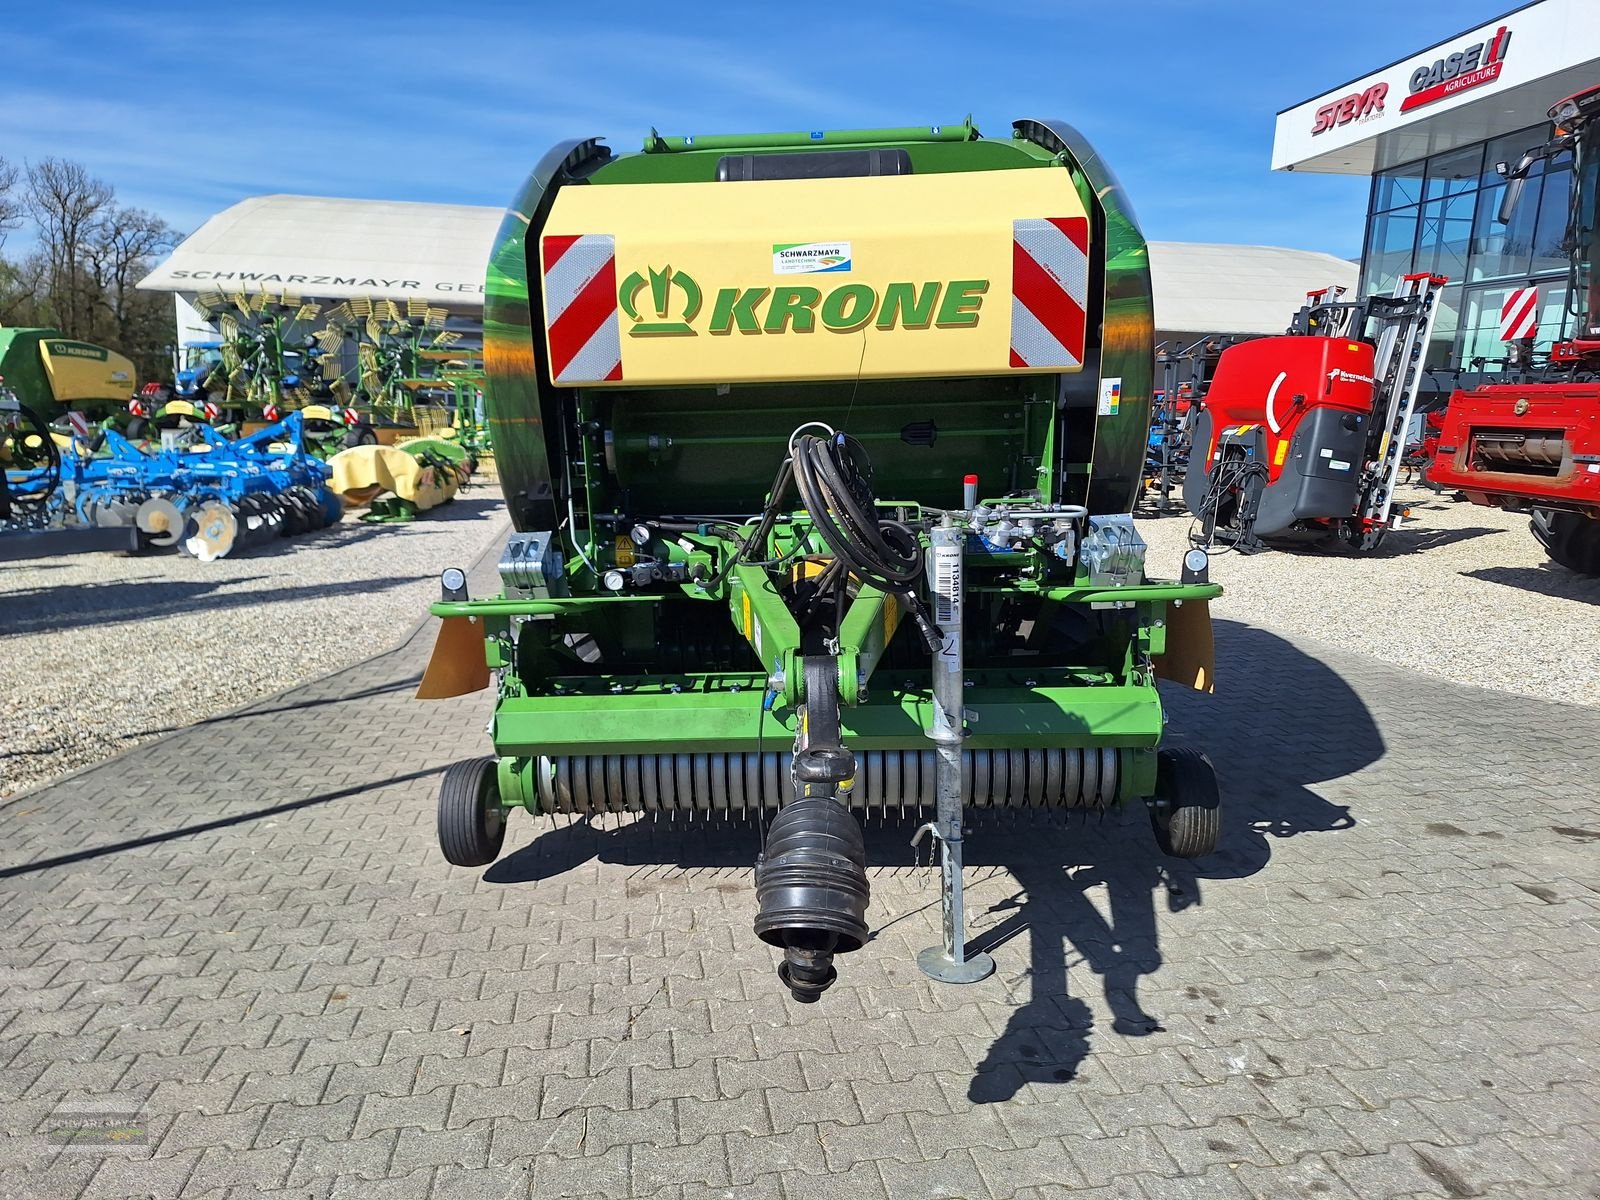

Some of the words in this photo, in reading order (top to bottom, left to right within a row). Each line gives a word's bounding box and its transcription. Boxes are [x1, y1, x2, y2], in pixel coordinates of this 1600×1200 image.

[1409, 43, 1484, 93] CASE
[1444, 66, 1496, 93] AGRICULTURE
[1311, 82, 1389, 136] STEYR
[780, 249, 840, 258] SCHWARZMAYR
[170, 270, 420, 289] SCHWARZMAYR
[709, 280, 990, 335] KRONE
[952, 563, 960, 604] 1134814
